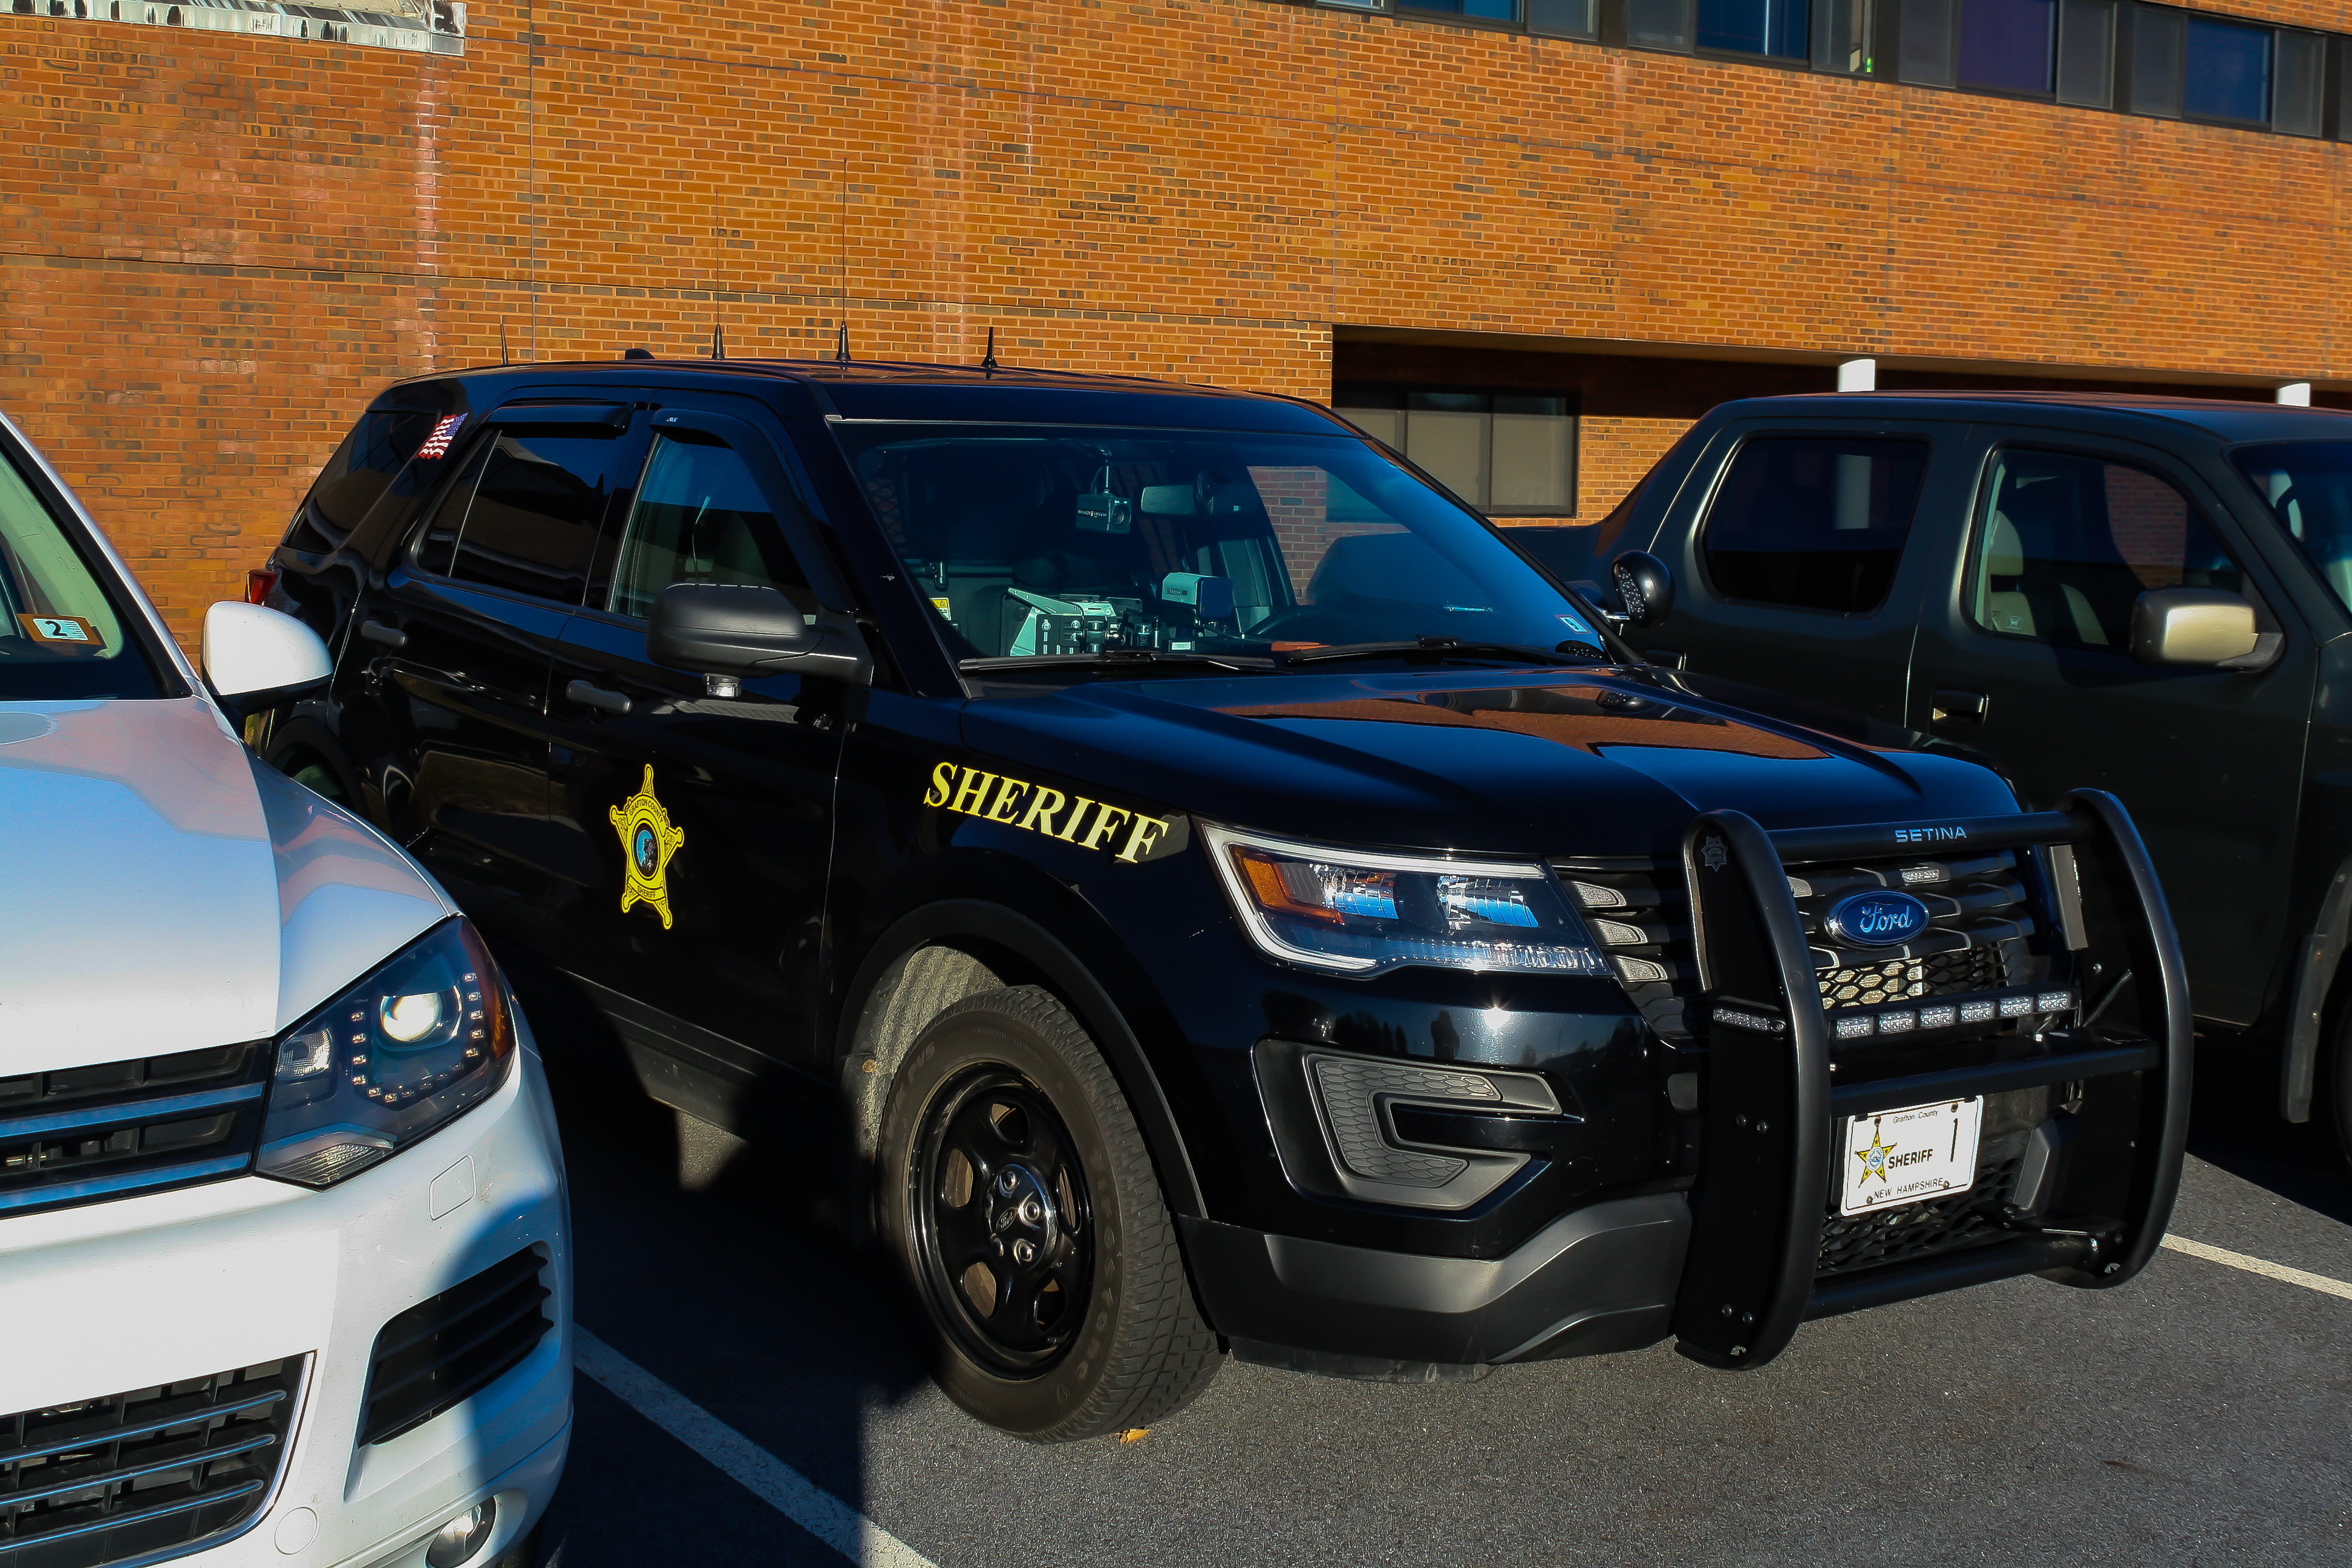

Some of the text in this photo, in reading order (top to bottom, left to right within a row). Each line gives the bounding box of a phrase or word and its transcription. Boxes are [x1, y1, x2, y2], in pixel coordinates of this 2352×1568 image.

[44, 620, 68, 637] 2
[923, 762, 1169, 863] SHERIFF
[1895, 826, 1967, 843] SETINA
[1859, 901, 1913, 933] Ford
[1892, 1109, 1939, 1124] Grafton County
[1950, 1117, 1959, 1163] 1
[1887, 1148, 1933, 1169] SHERIFF
[1873, 1177, 1944, 1200] NEW HAMPSHIRE
